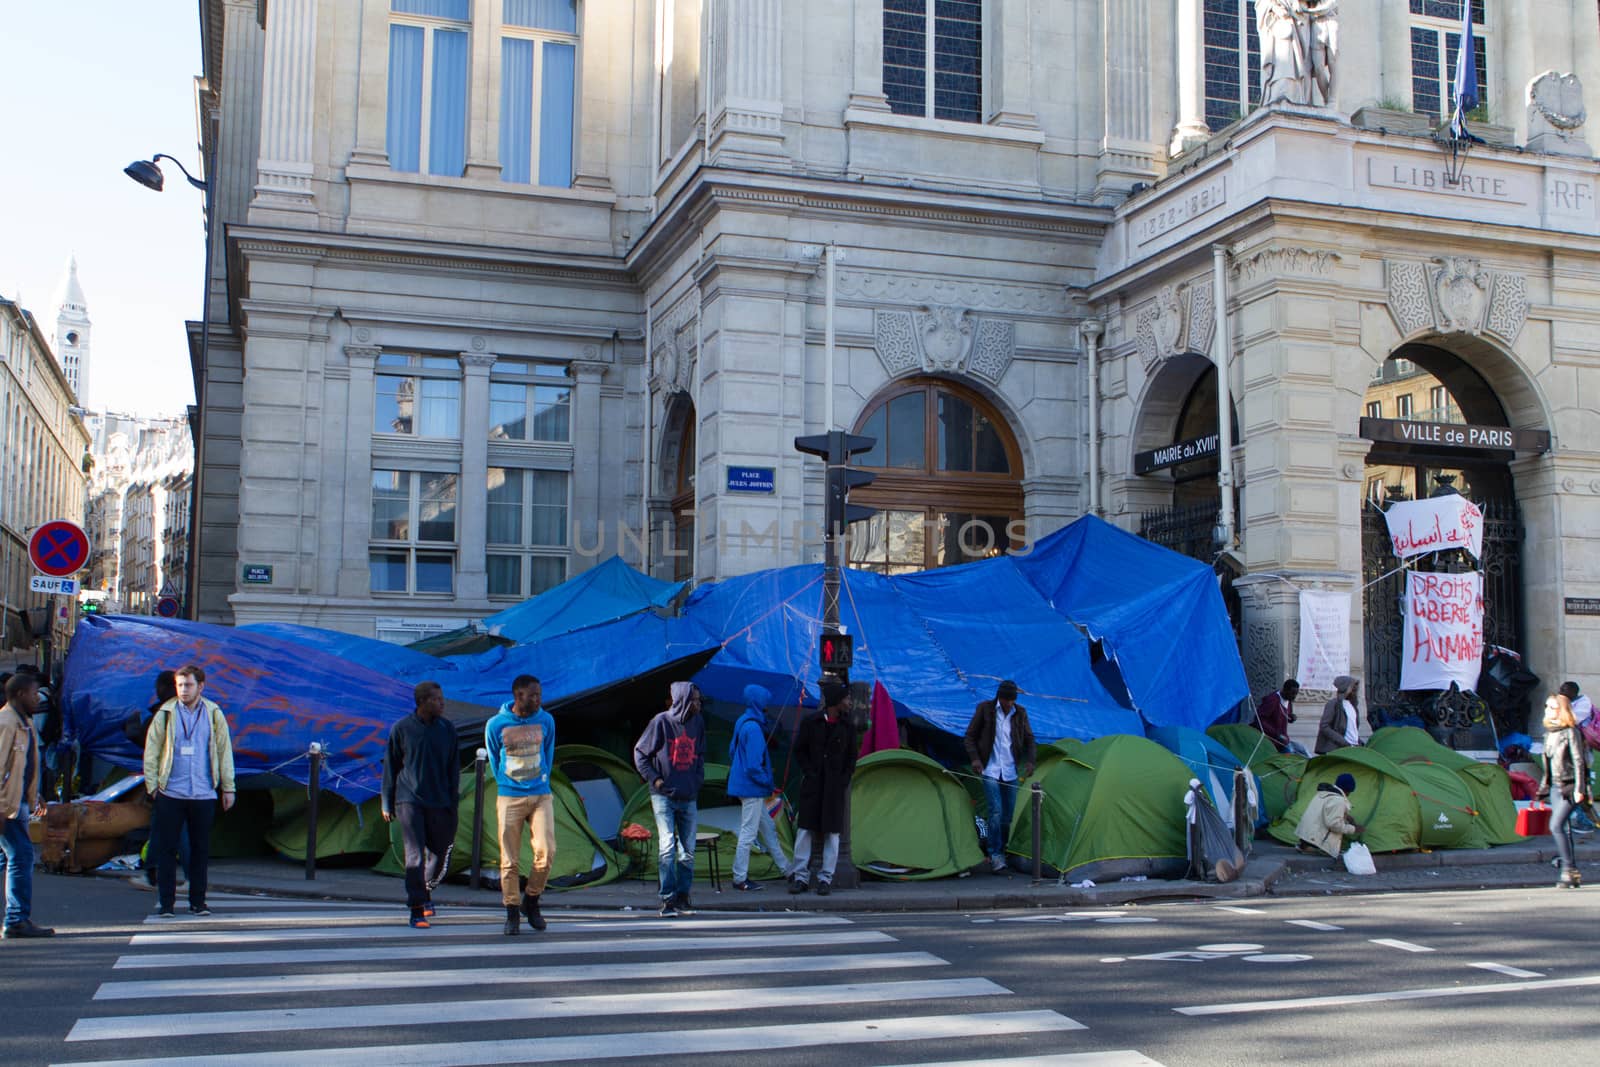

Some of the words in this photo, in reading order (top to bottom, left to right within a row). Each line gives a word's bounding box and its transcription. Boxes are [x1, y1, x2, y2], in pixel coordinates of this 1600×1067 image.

[1392, 165, 1508, 196] LIBERTE
[1401, 423, 1441, 441] VILLE
[1445, 429, 1464, 443] de
[1469, 428, 1513, 446] PARIS
[1154, 444, 1182, 465] MAIRIE
[1184, 445, 1195, 457] du
[33, 579, 60, 590] SAUF
